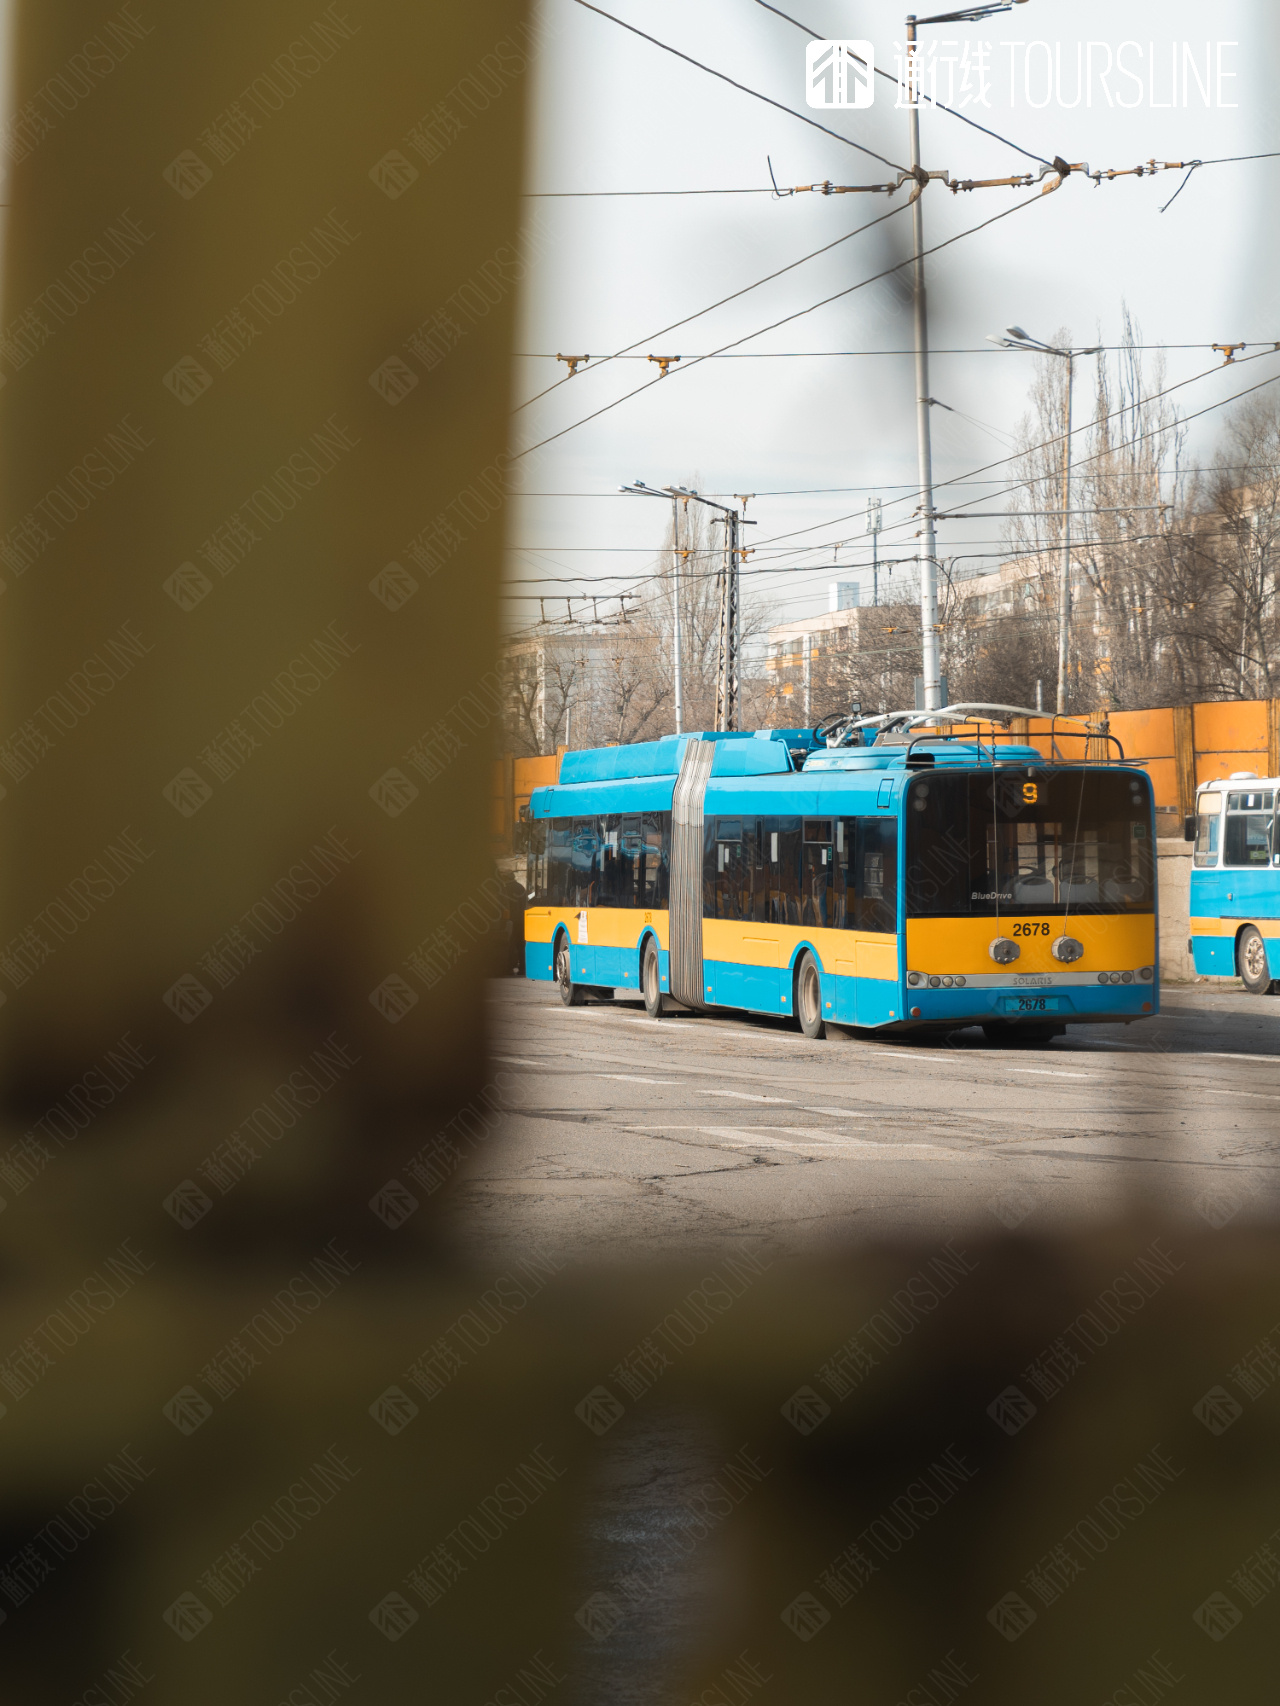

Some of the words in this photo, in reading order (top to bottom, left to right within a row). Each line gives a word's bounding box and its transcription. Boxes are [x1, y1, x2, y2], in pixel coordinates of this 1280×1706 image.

[1022, 782, 1038, 804] 9
[970, 891, 1013, 901] BlueDrive
[1012, 922, 1051, 937] 2678
[1012, 977, 1053, 986] SOLARIS
[1017, 998, 1046, 1011] 2678
